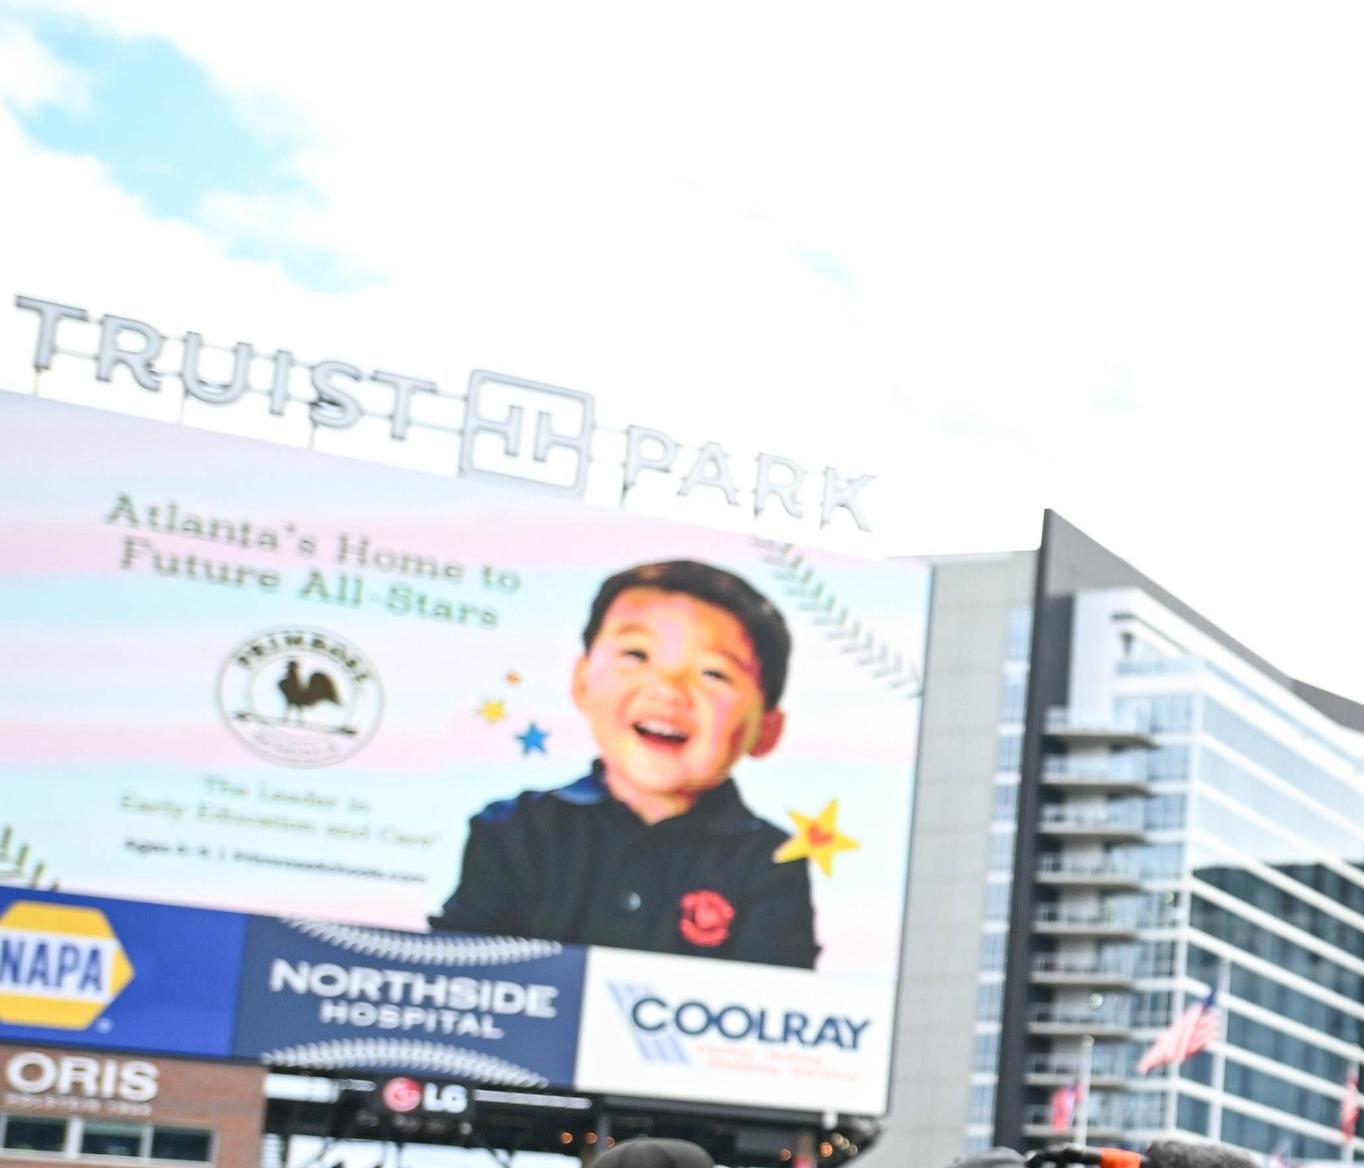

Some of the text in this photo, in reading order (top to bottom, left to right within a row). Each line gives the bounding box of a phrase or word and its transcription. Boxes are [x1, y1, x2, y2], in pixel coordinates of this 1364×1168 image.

[15, 295, 877, 532] TRUIST PARK
[105, 492, 521, 592] Atlanta's Home to
[120, 535, 281, 591] Future
[0, 938, 103, 992] NAPA
[269, 958, 559, 1019] NORTHSIDE
[319, 998, 505, 1040] HOSPITAL
[631, 996, 873, 1051] COOLRAY
[7, 1052, 159, 1102] ORIS
[423, 1082, 468, 1114] LG
